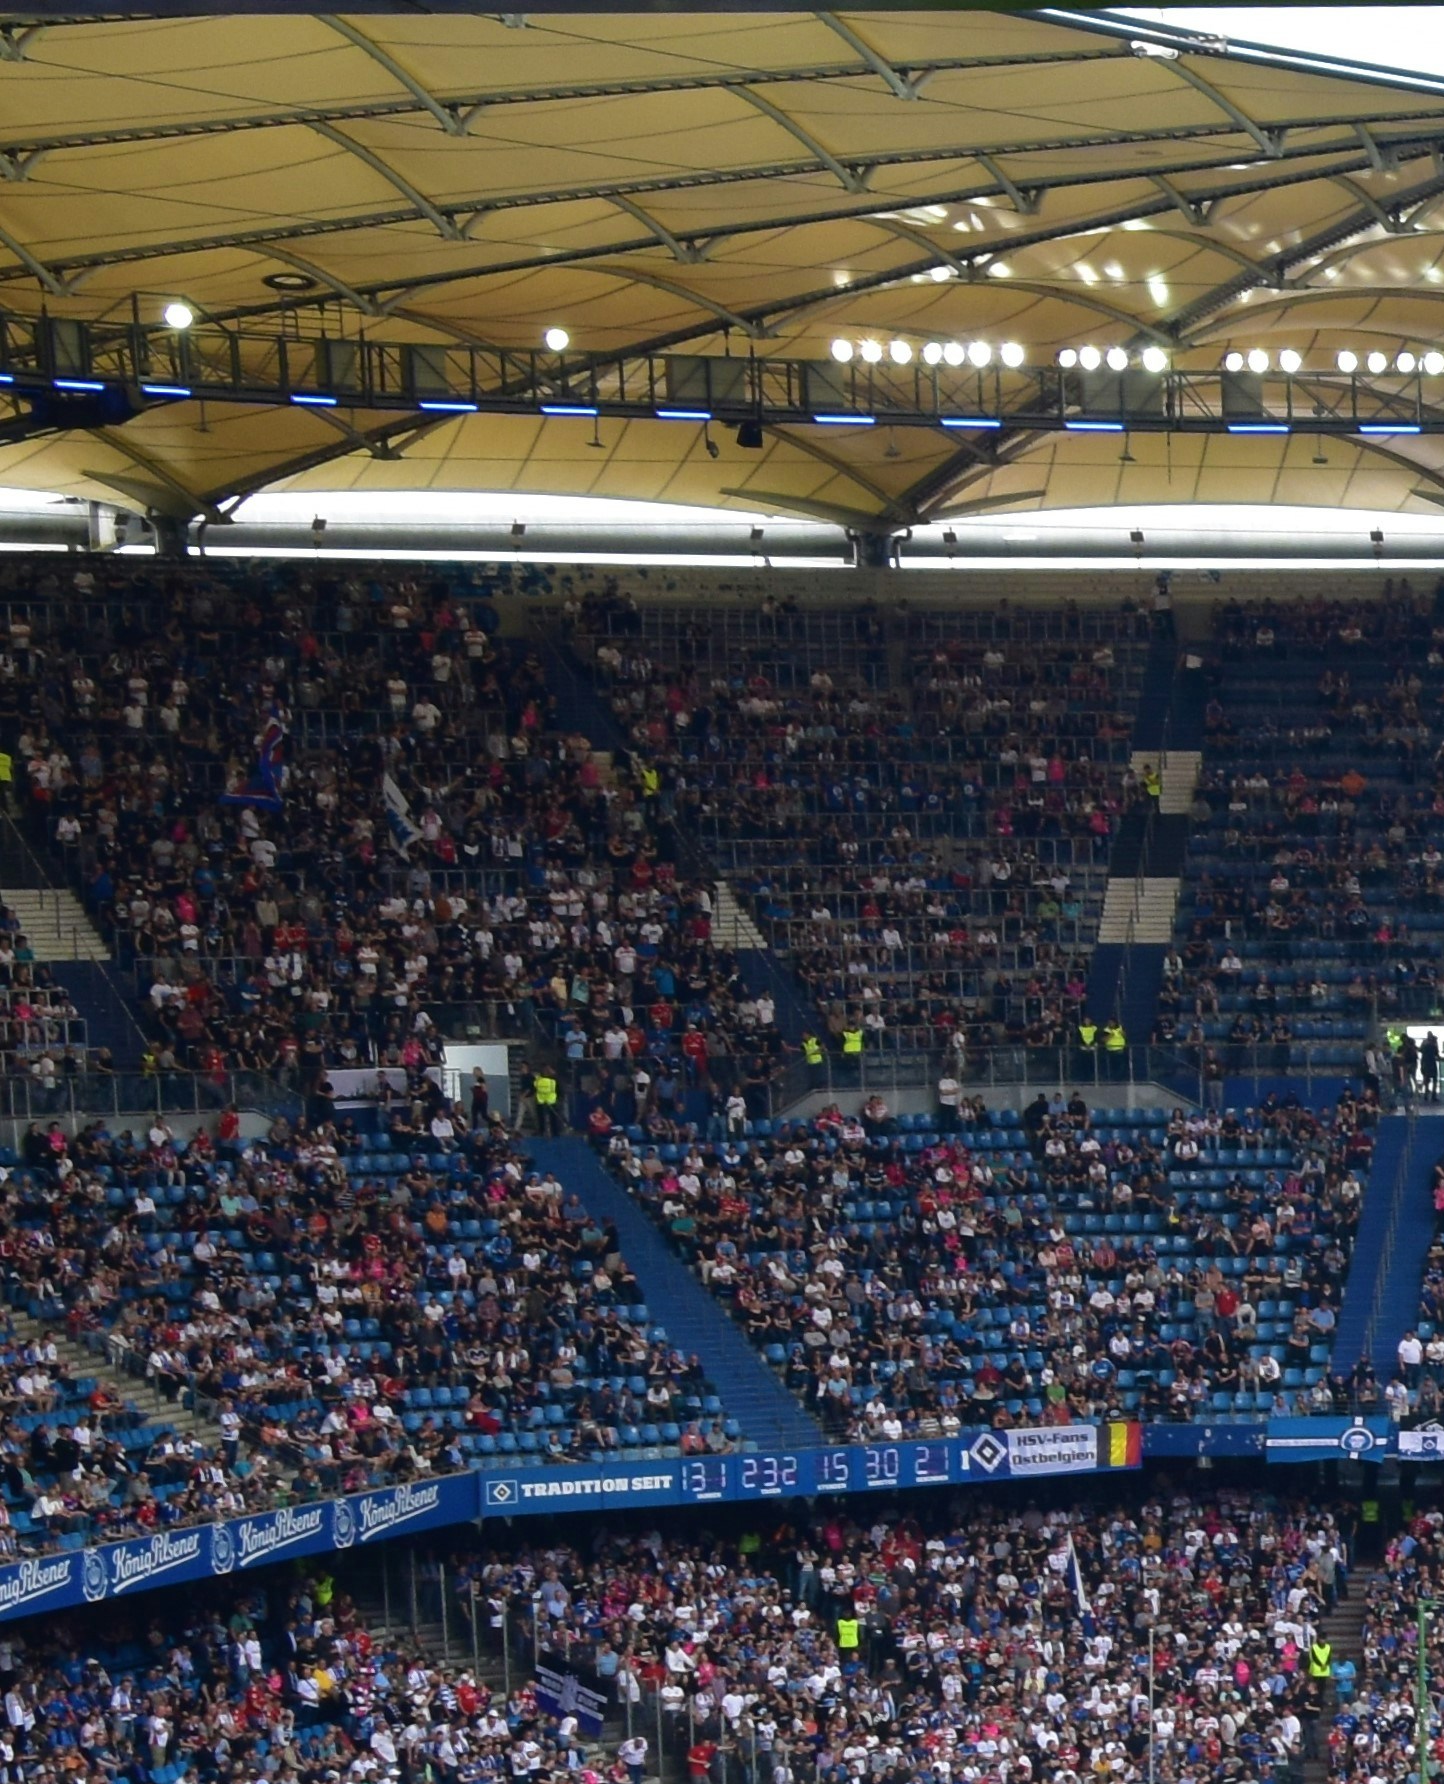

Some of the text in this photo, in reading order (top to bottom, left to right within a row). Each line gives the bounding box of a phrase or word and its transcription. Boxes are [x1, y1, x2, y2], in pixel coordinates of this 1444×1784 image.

[1016, 1432, 1089, 1446] HSV-Fans
[1011, 1449, 1097, 1468] Ostbelgien
[521, 1474, 673, 1498] TRADITION SEIT
